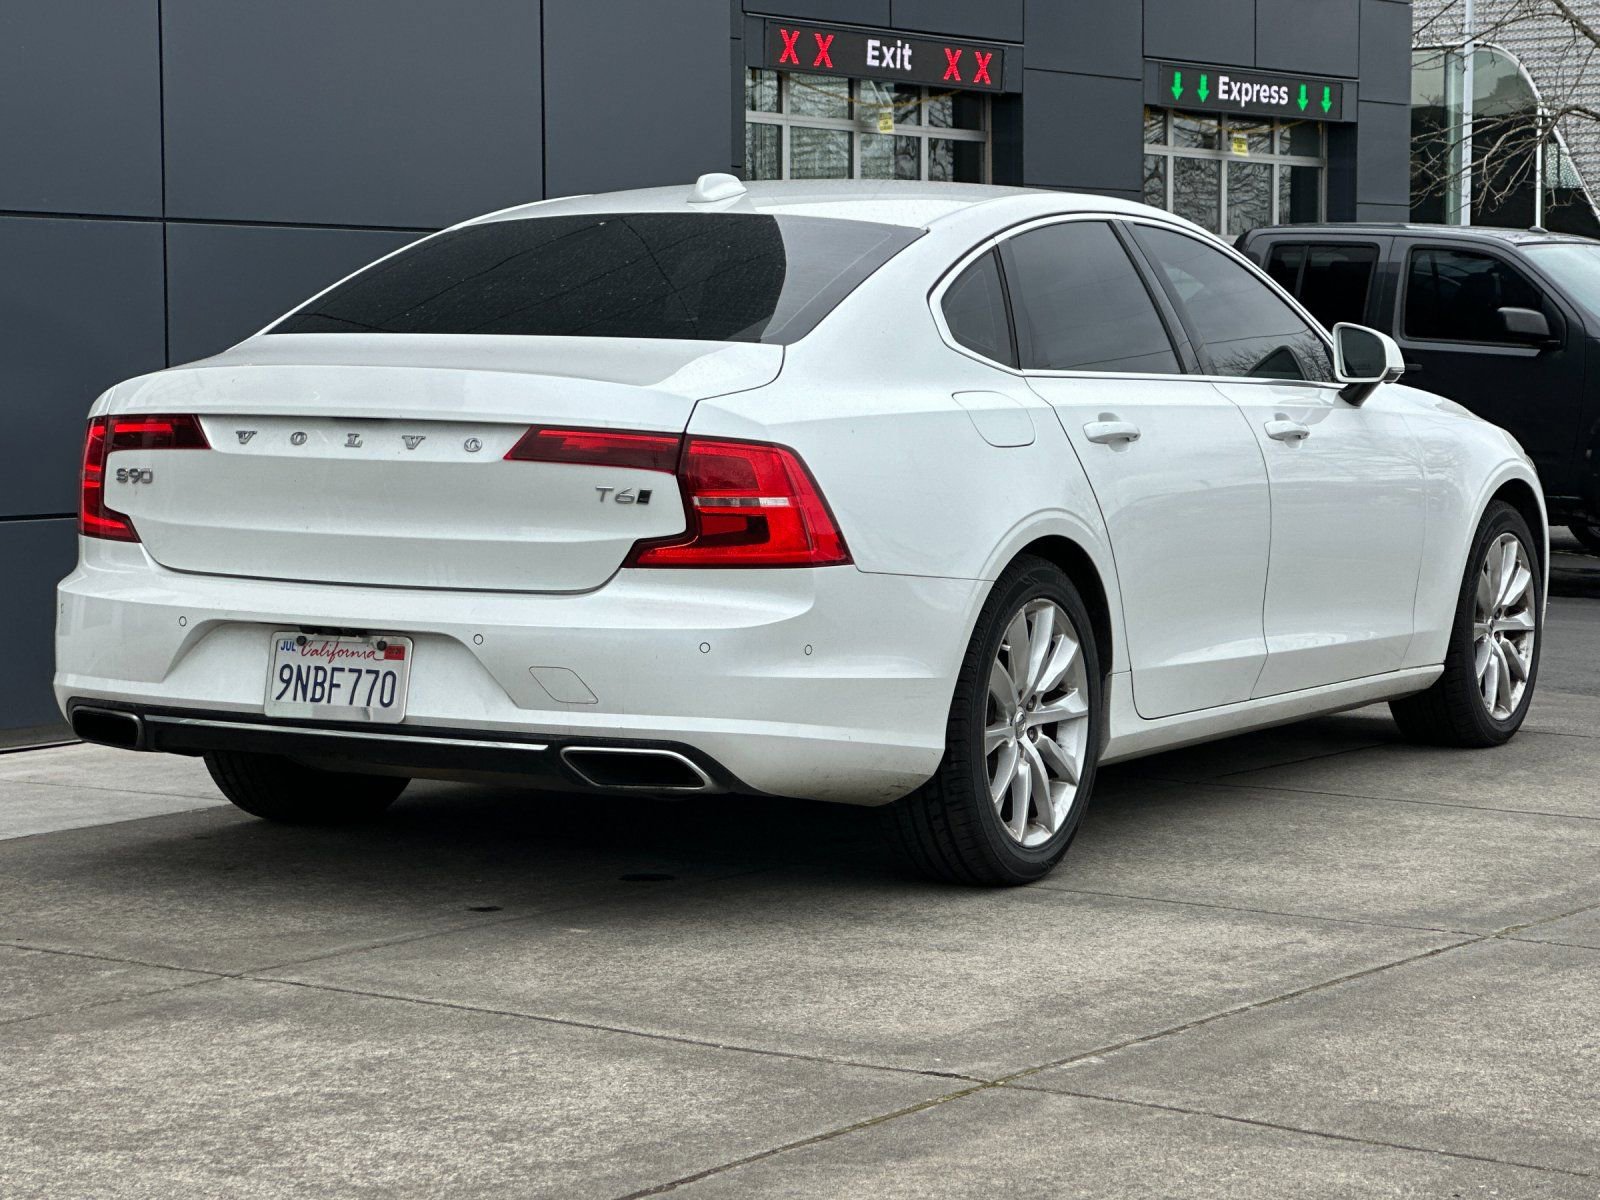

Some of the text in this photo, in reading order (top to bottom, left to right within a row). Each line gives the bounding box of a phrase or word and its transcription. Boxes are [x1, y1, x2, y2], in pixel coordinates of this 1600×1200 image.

[866, 39, 913, 71] Exit
[1217, 75, 1289, 107] Express
[235, 430, 483, 453] VOLVO
[116, 467, 154, 484] S90
[595, 485, 636, 504] T6
[280, 640, 296, 652] JUL
[300, 640, 384, 664] California
[275, 663, 397, 708] 9NBF770
